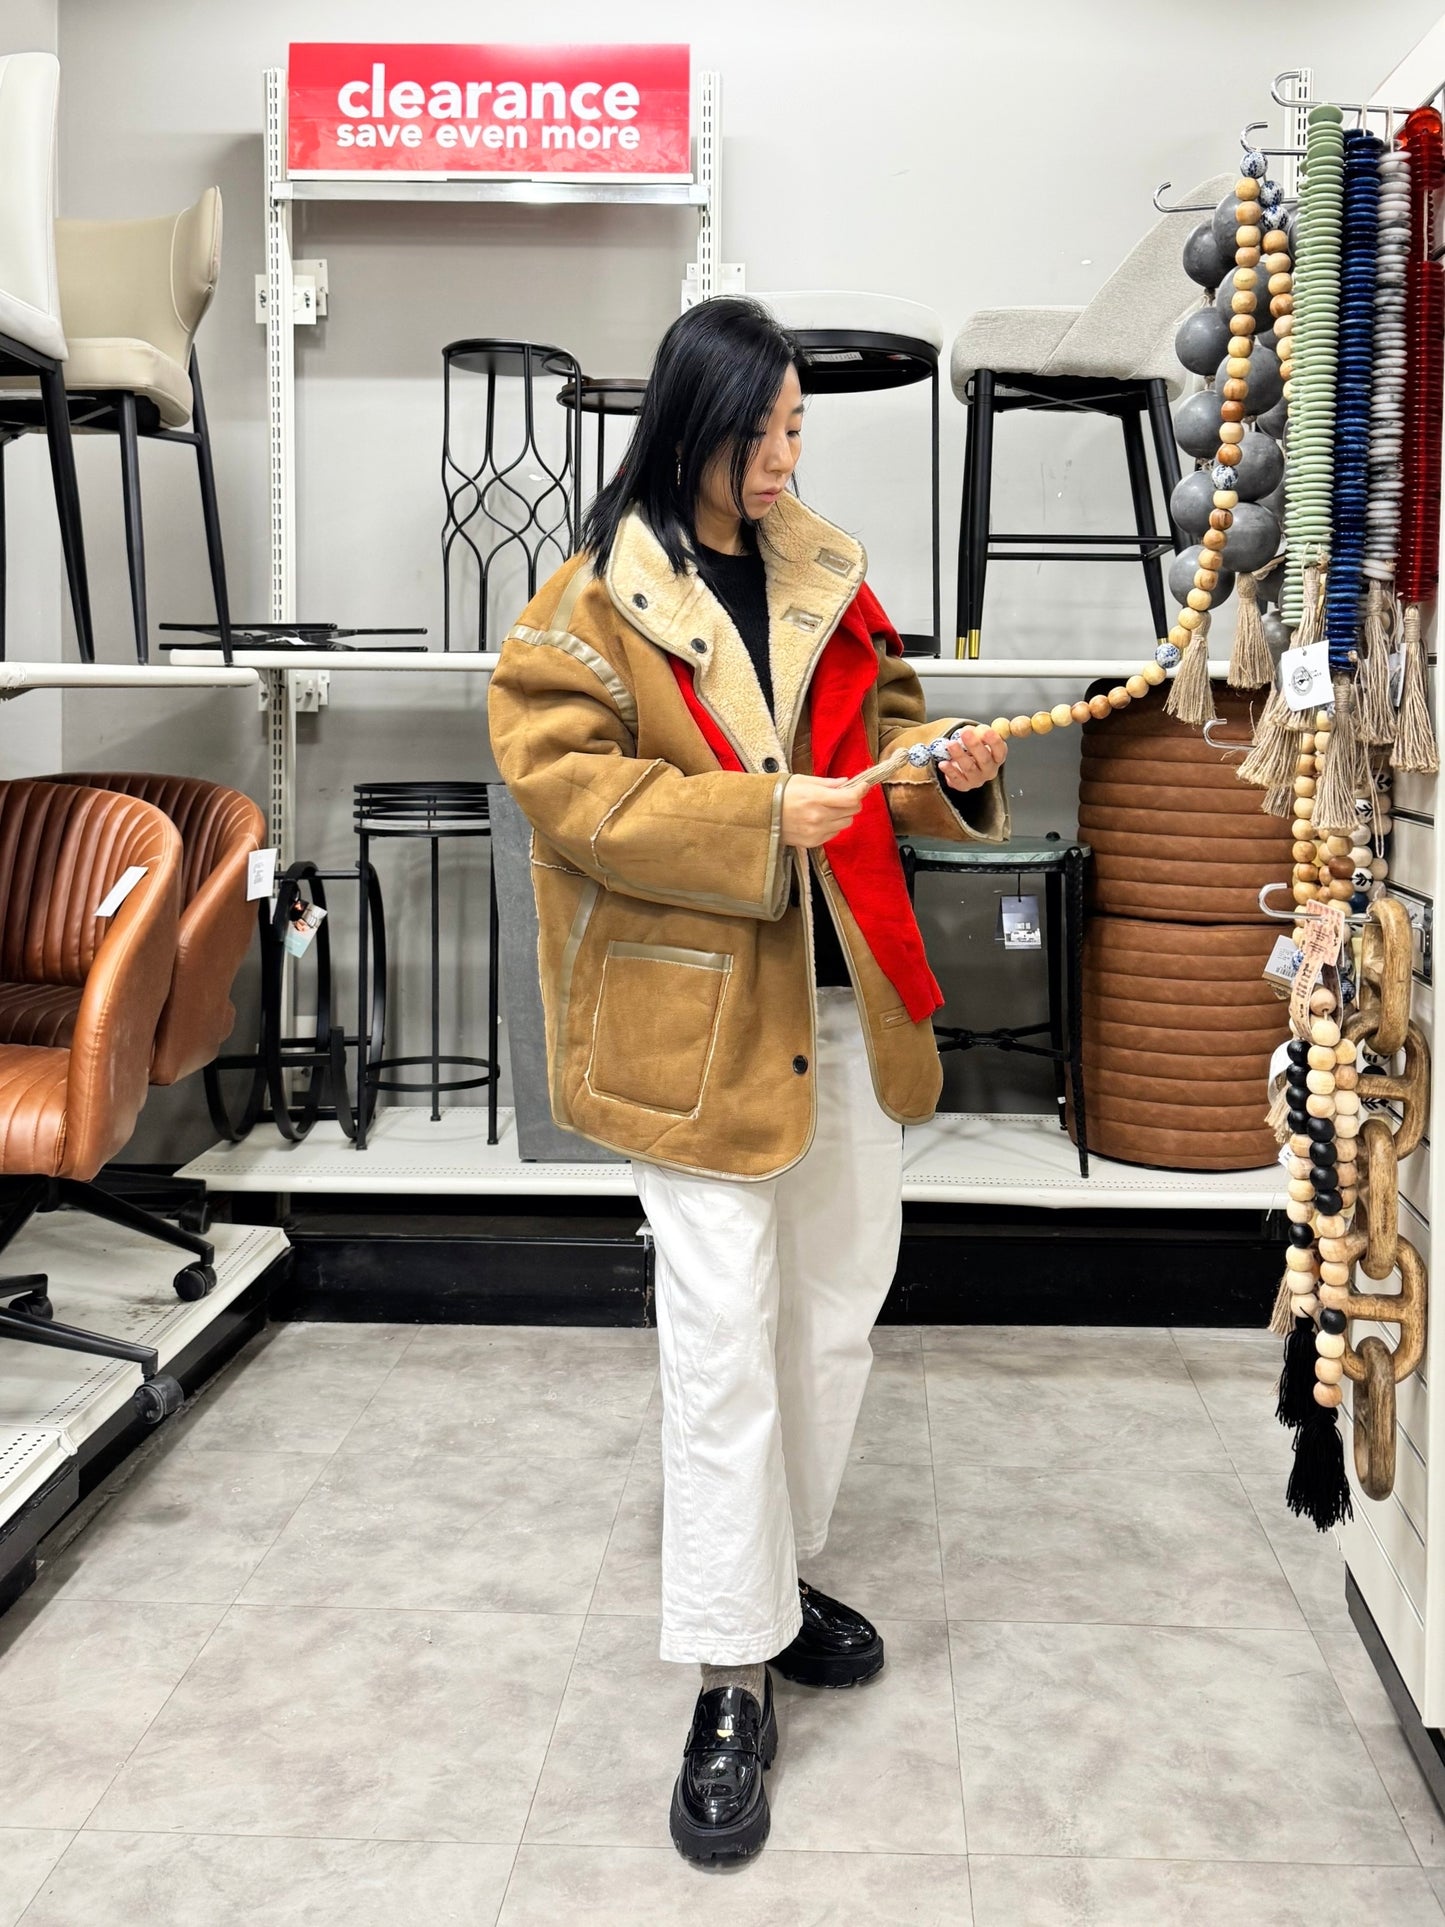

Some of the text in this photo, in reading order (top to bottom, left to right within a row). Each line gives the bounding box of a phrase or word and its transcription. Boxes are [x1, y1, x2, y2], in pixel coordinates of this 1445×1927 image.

[337, 62, 641, 121] clearance
[336, 123, 641, 150] save even more
